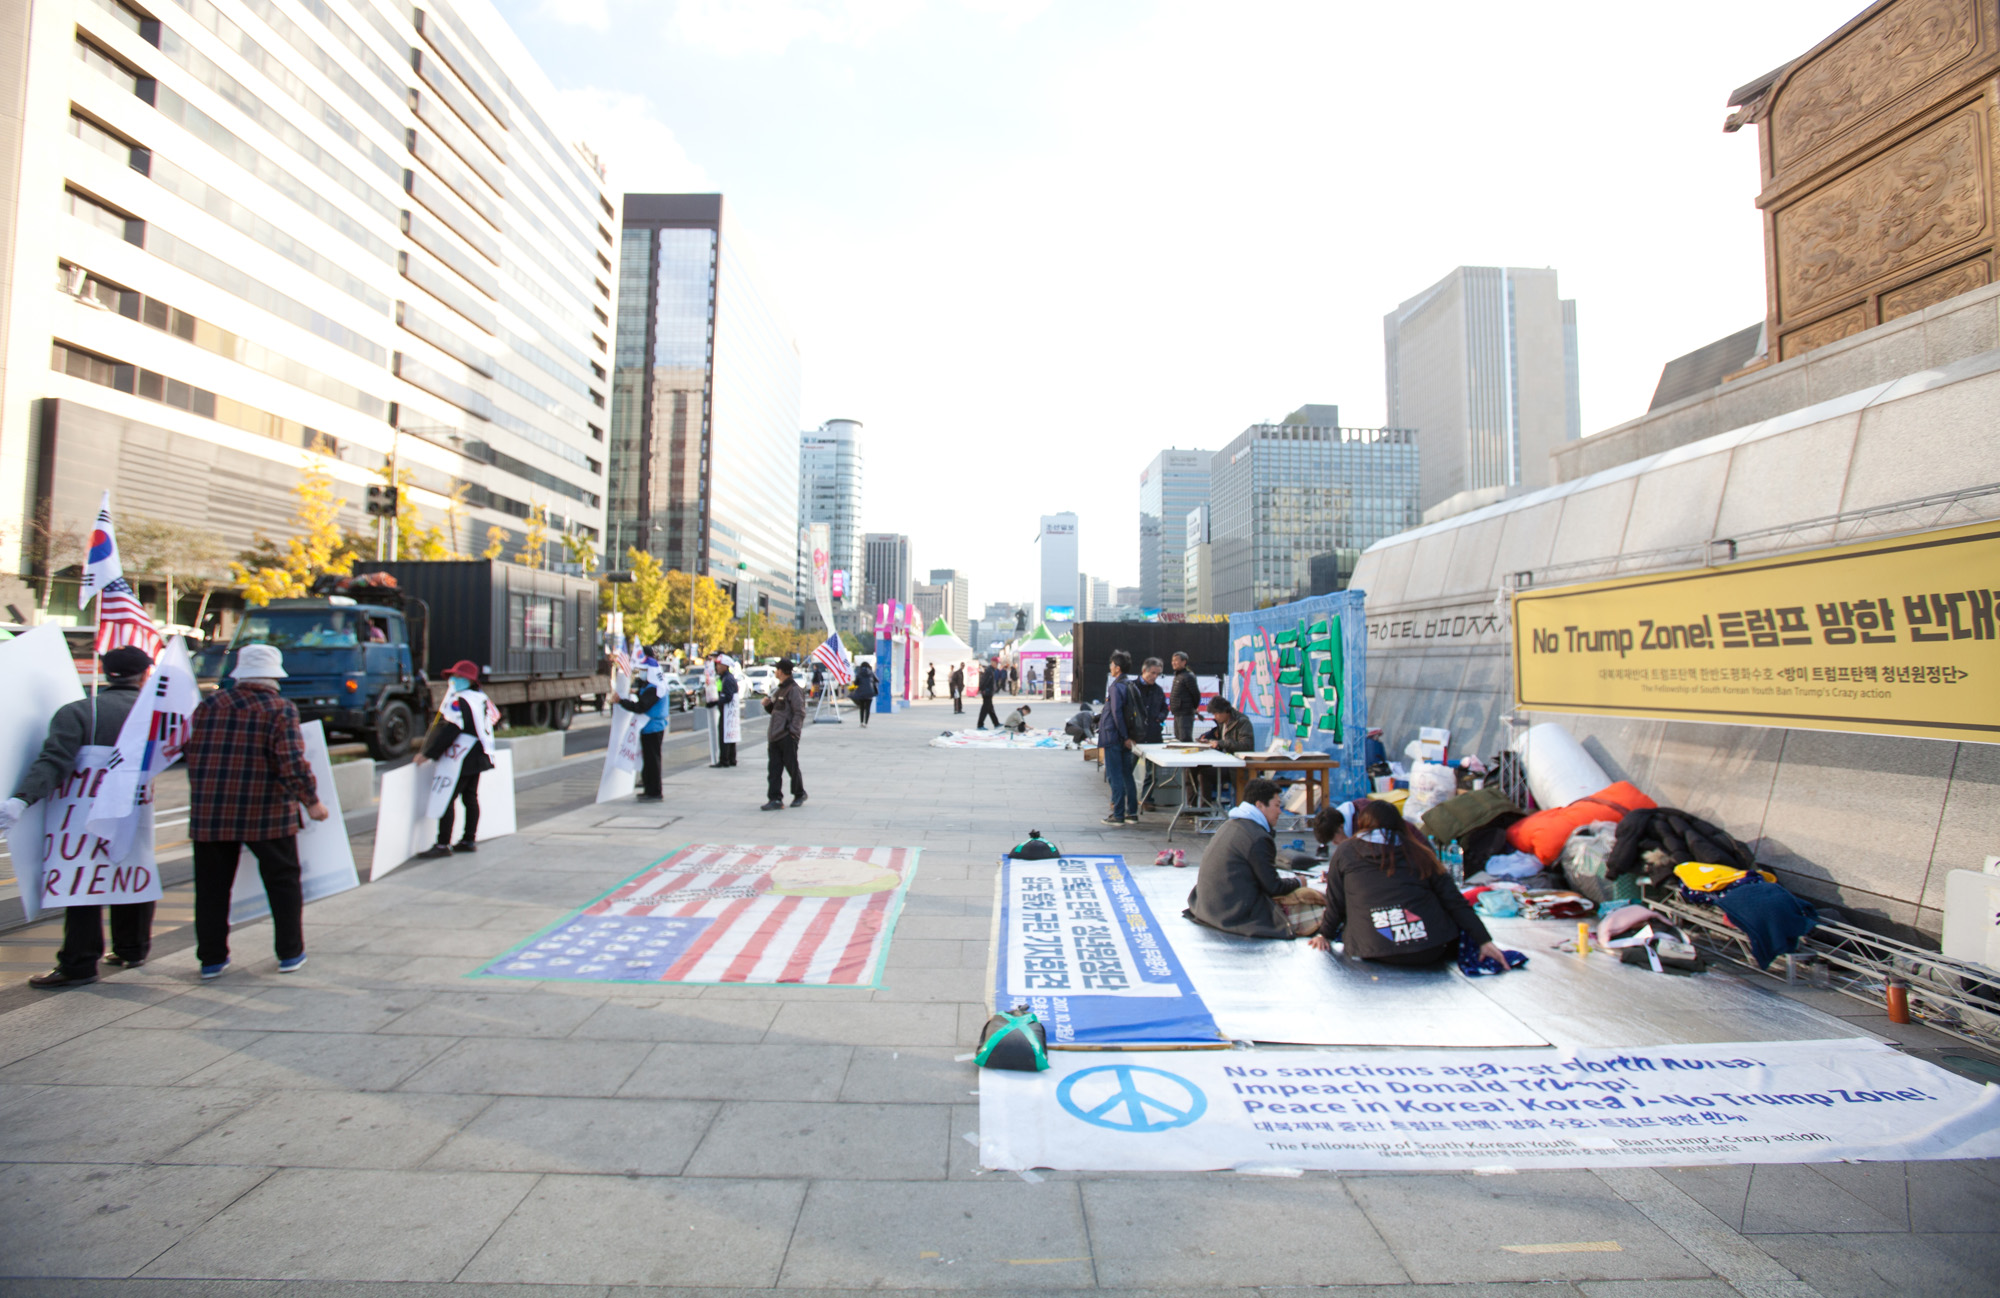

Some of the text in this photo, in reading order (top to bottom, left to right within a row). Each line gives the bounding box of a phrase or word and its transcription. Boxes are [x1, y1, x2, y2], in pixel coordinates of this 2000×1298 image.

[1533, 589, 2000, 659] No Trump Zone! 트럼프 방한 반대
[1700, 667, 1774, 681] 한반도평화수호
[1812, 666, 1878, 683] 트럼프탄핵
[1881, 665, 1969, 684] 청년원정단>
[1700, 686, 1721, 694] South
[1723, 686, 1750, 695] Korean
[1751, 686, 1775, 696] Youth
[1776, 687, 1793, 697] Ban
[1794, 687, 1830, 699] Trump's
[1832, 687, 1858, 700] Crazy
[1860, 687, 1892, 699] action
[44, 864, 151, 896] RIEND
[1022, 913, 1061, 933] 규탄
[1391, 921, 1428, 943] 지성
[1023, 935, 1071, 989] 기자회견
[1071, 925, 1130, 990] 청년원정단
[1223, 1066, 1268, 1077] No
[1276, 1064, 1434, 1077] sanctions
[1233, 1080, 1381, 1098] Impeach
[1385, 1079, 1510, 1095] Donald
[1243, 1100, 1347, 1114] Peace
[1351, 1099, 1390, 1113] in
[1394, 1098, 1515, 1113] Korea!
[1711, 1092, 1834, 1107] Trump
[1827, 1087, 1938, 1101] Zone!
[1253, 1121, 1334, 1132] 대북제재
[1390, 1120, 1450, 1132] 트럼프
[1450, 1119, 1502, 1131] 탄핵!
[1598, 1116, 1661, 1128] 트럼프
[1658, 1113, 1700, 1127] 방한
[1267, 1142, 1298, 1151] The
[1301, 1141, 1392, 1153] Fellowship
[1394, 1141, 1411, 1150] of
[1414, 1140, 1464, 1150] South
[1465, 1140, 1526, 1150] Korean
[1526, 1139, 1577, 1149] Youth
[1611, 1137, 1653, 1149] (Ban
[1653, 1135, 1722, 1148] Trump's
[1723, 1134, 1770, 1145] Crazy
